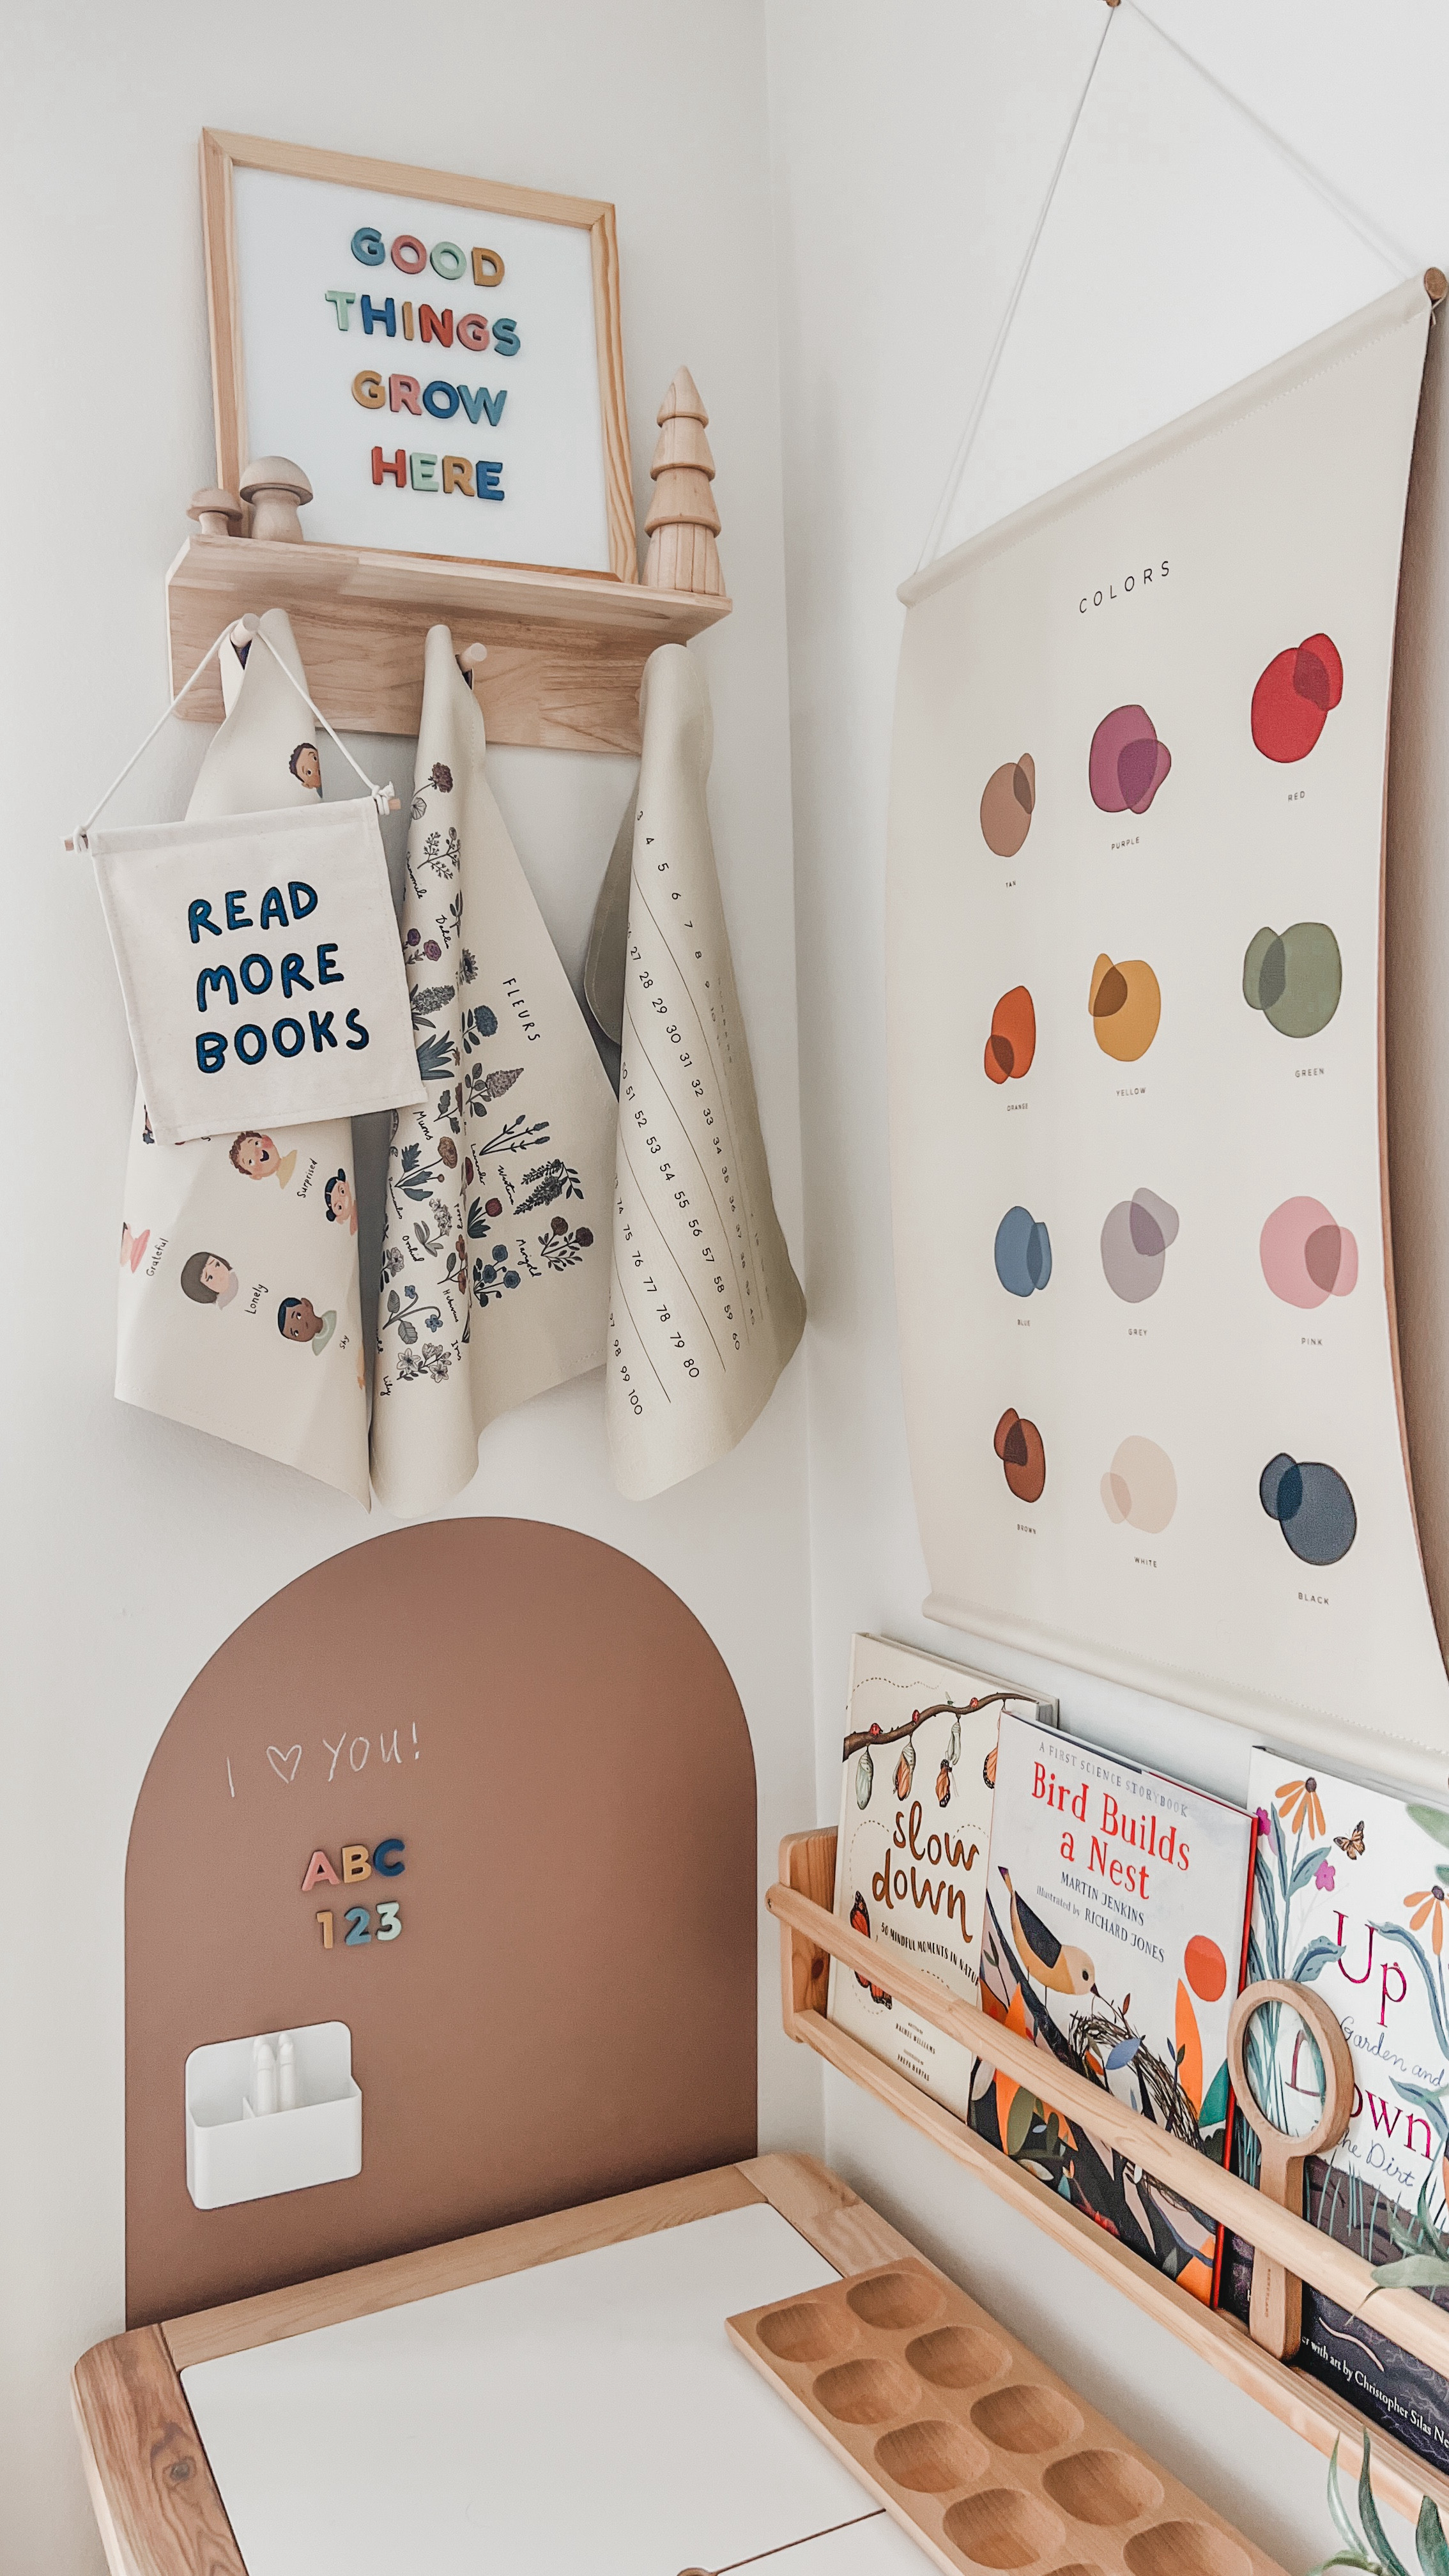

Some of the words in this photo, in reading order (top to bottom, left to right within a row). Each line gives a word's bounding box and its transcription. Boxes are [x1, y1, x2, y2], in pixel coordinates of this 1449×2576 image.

[351, 227, 505, 287] GOOD
[325, 289, 521, 356] THINGS
[351, 370, 508, 426] GROW
[371, 447, 505, 501] HERE
[1079, 560, 1170, 613] COLORS
[1287, 790, 1306, 802] RED
[1111, 836, 1140, 851] PURPLE
[645, 837, 655, 845] 4
[657, 862, 670, 872] 5
[671, 892, 682, 900] 6
[684, 920, 693, 929] 7
[694, 950, 702, 959] 8
[1005, 880, 1016, 888] TAN
[188, 881, 318, 944] READ
[197, 943, 344, 1012] MORE
[502, 977, 540, 1042] FLEURS
[195, 1008, 370, 1073] BOOKS
[630, 946, 641, 961] 27
[640, 971, 654, 988] 28
[652, 998, 668, 1014] 29
[666, 1025, 682, 1043] 30
[679, 1052, 693, 1068] 31
[691, 1079, 704, 1098] 32
[702, 1108, 714, 1126] 33
[712, 1137, 722, 1154] 34
[721, 1166, 730, 1184] 35
[728, 1196, 737, 1213] 36
[1116, 1087, 1147, 1097] YELLOW
[1294, 1068, 1325, 1078] GREEN
[413, 1111, 433, 1140] Mums
[1006, 1103, 1029, 1112] ORANGE
[297, 1158, 319, 1199] Surprised
[625, 1085, 636, 1101] 51
[634, 1110, 648, 1128] 52
[645, 1136, 661, 1154] 53
[659, 1163, 675, 1181] 54
[673, 1191, 690, 1209] 55
[688, 1219, 703, 1238] 56
[702, 1247, 715, 1264] 57
[713, 1276, 725, 1294] 58
[723, 1305, 733, 1321] 59
[732, 1332, 740, 1351] 60
[146, 1237, 169, 1276] Grateful
[402, 1235, 425, 1262] Orchid
[516, 1239, 542, 1277] Marigold
[244, 1283, 269, 1315] Lonely
[624, 1223, 633, 1241] 75
[632, 1250, 644, 1268] 76
[643, 1276, 657, 1293] 77
[656, 1304, 671, 1322] 78
[670, 1331, 686, 1349] 79
[683, 1358, 700, 1378] 80
[1017, 1319, 1031, 1327] BLUE
[340, 1335, 349, 1349] Shy
[1128, 1328, 1148, 1337] GREY
[1301, 1337, 1322, 1346] PINK
[379, 1375, 392, 1397] Lily
[613, 1339, 622, 1357] 98
[620, 1366, 631, 1382] 99
[629, 1388, 643, 1415] 100
[1016, 1523, 1037, 1535] BROWN
[1134, 1556, 1158, 1568] WHITE
[1297, 1591, 1330, 1606] BLACK
[226, 1756, 235, 1798] I
[1039, 1742, 1045, 1752] A
[1049, 1745, 1077, 1767] FIRST
[1080, 1759, 1121, 1787] SCIENCE
[1125, 1779, 1190, 1818] STORYBOOK
[893, 1800, 980, 1871] slow
[1031, 1761, 1089, 1823] Bird
[1100, 1793, 1190, 1871] Builds
[301, 1838, 406, 1892] ABC
[1060, 1832, 1075, 1862] a
[1087, 1835, 1150, 1900] Nest
[872, 1848, 973, 1943] down
[1060, 1871, 1099, 1901] MARTIN
[1101, 1892, 1145, 1927] JENKINS
[316, 1901, 402, 1949] 123
[881, 1922, 889, 1936] 50
[890, 1928, 916, 1951] MINDFUL
[917, 1940, 949, 1959] MOMENTS
[950, 1951, 957, 1966] IN
[1072, 1903, 1081, 1917] by
[1084, 1908, 1128, 1942] RICHARD
[1130, 1933, 1165, 1963] JONES
[1333, 1910, 1407, 2028] Up
[1340, 2016, 1407, 2072] Garden
[1411, 2068, 1445, 2087] and
[1337, 2126, 1361, 2159] he
[1366, 2139, 1416, 2188] Dirt
[1311, 2339, 1328, 2361] with
[1330, 2356, 1342, 2371] art
[1343, 2359, 1354, 2382] by
[1354, 2370, 1409, 2419] Christopher
[1410, 2409, 1432, 2437] Silas
